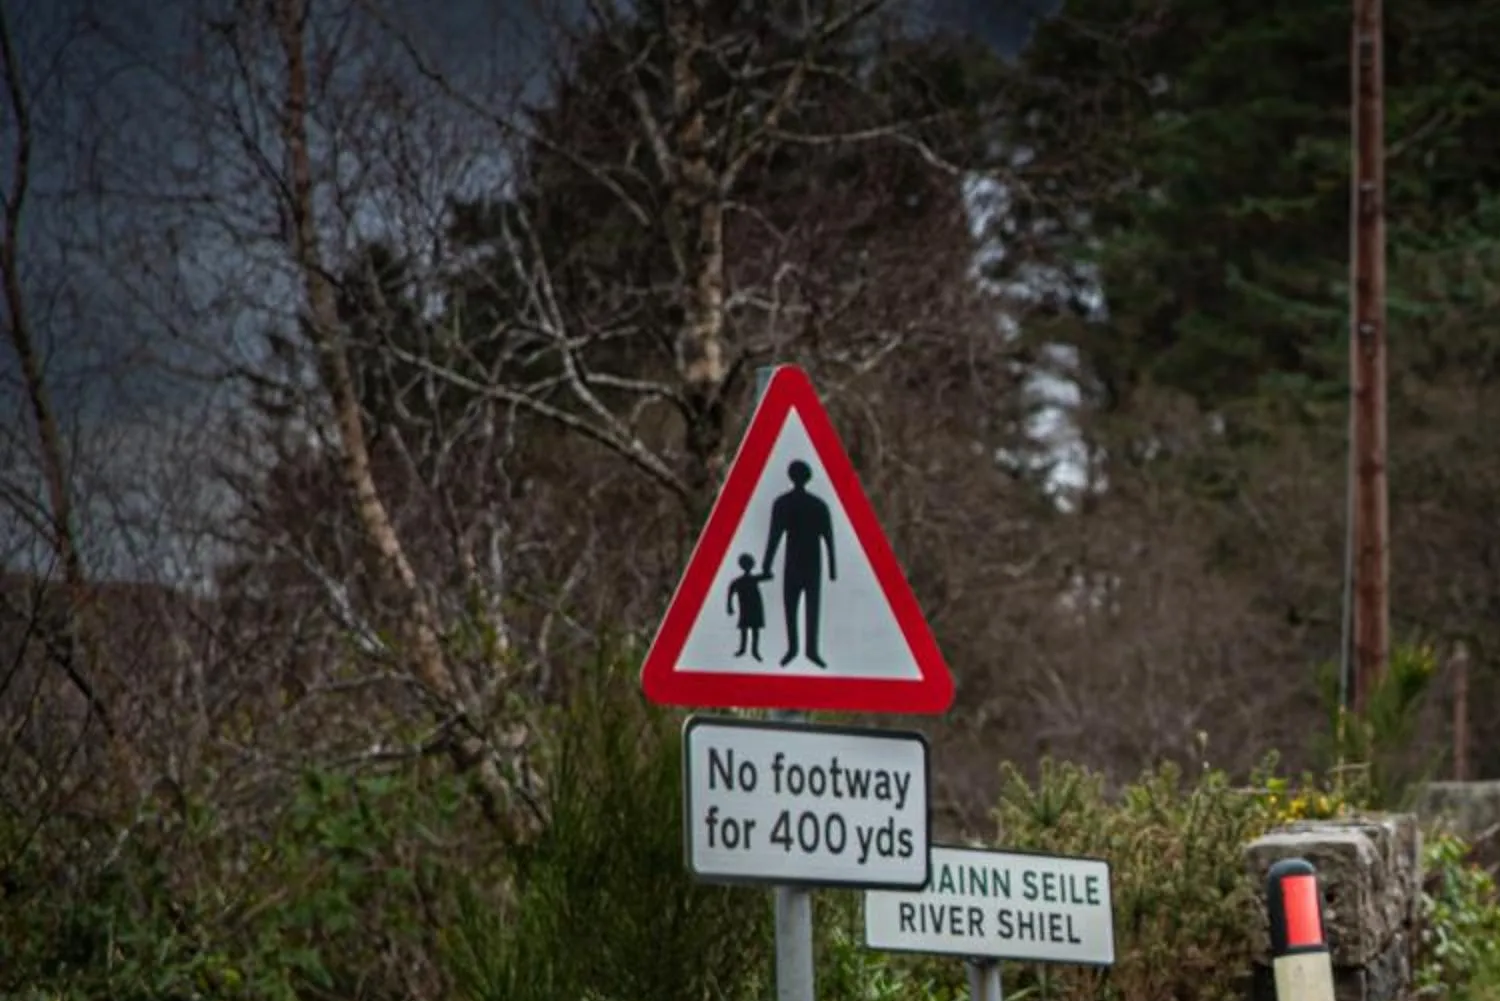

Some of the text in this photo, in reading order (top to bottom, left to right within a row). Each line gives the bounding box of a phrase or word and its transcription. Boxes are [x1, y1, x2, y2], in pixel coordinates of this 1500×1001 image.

[708, 747, 911, 810] No footway
[705, 805, 914, 865] for 400 yds
[929, 864, 1101, 906] AINN SEILE
[900, 902, 1082, 944] RIVER SHIEL
